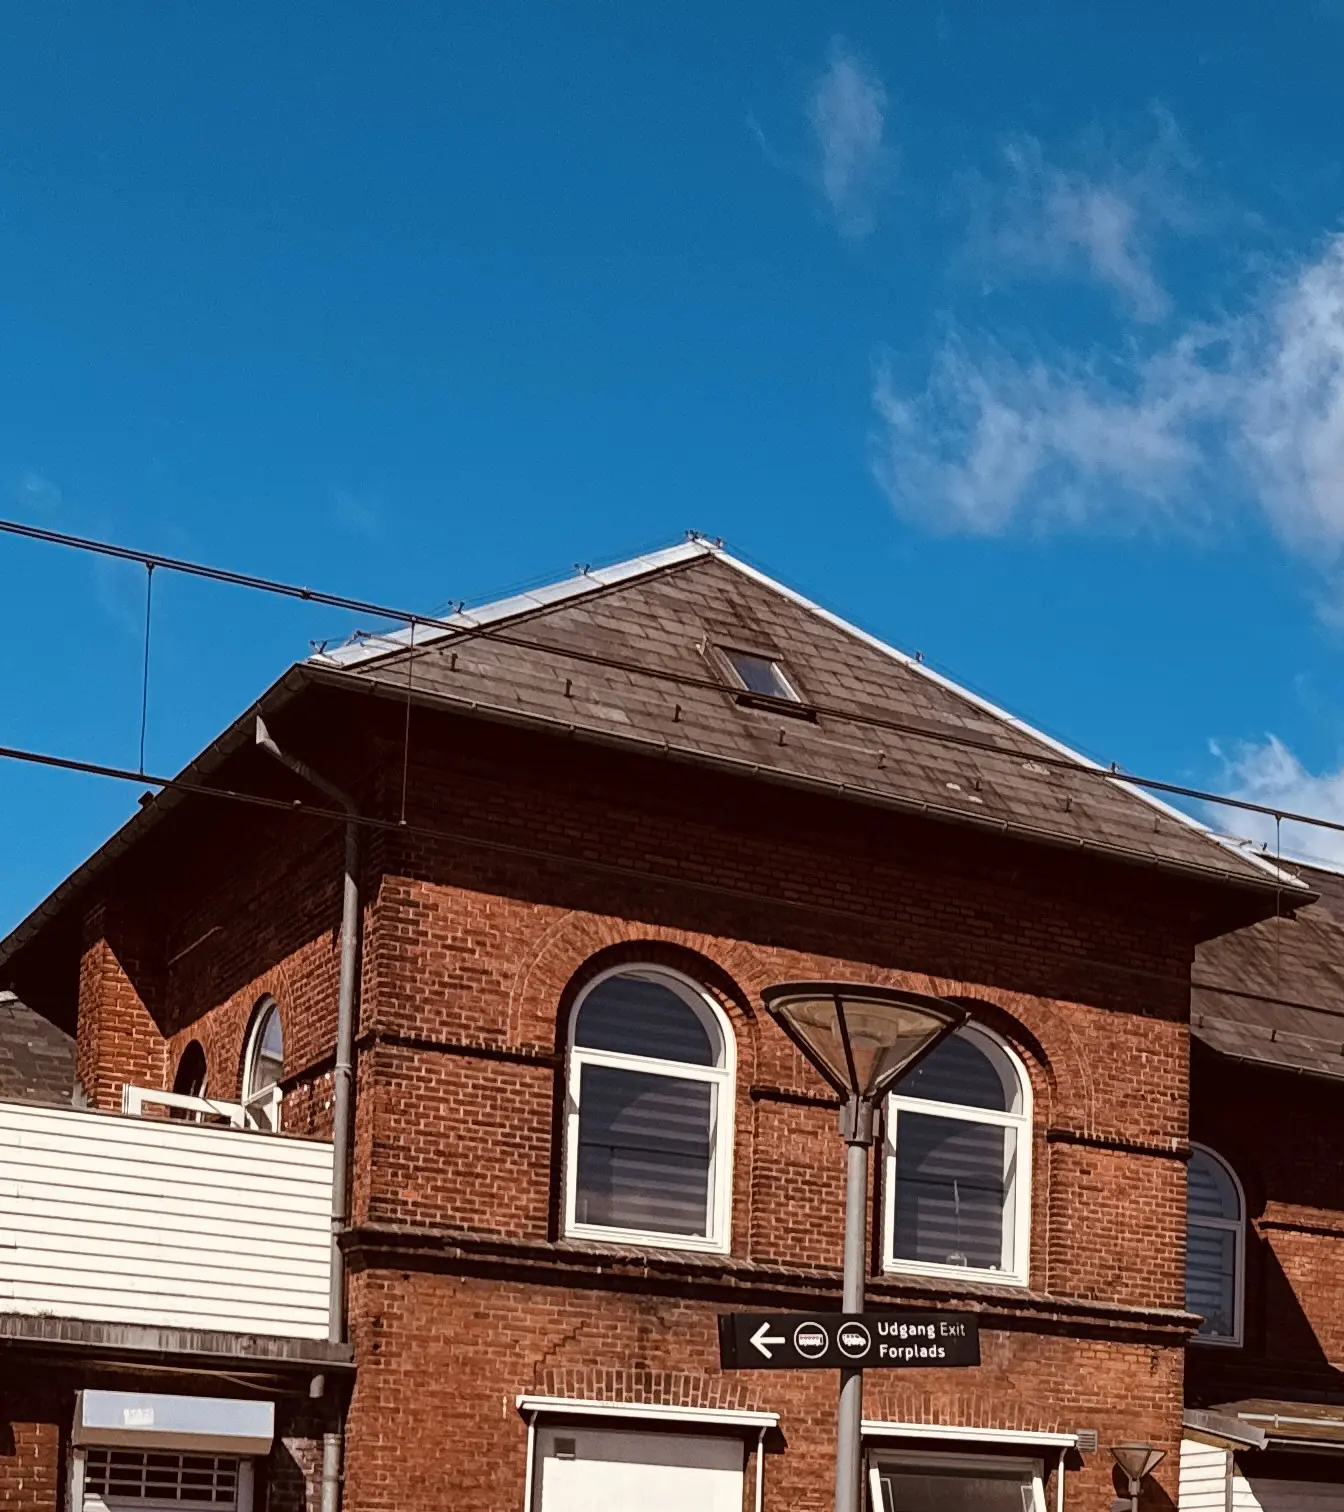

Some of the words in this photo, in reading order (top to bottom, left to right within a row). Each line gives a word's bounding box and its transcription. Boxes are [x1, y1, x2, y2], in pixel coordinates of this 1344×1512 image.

[877, 1321, 936, 1339] Udgang
[940, 1321, 966, 1337] Exit
[879, 1344, 946, 1361] Forplads
